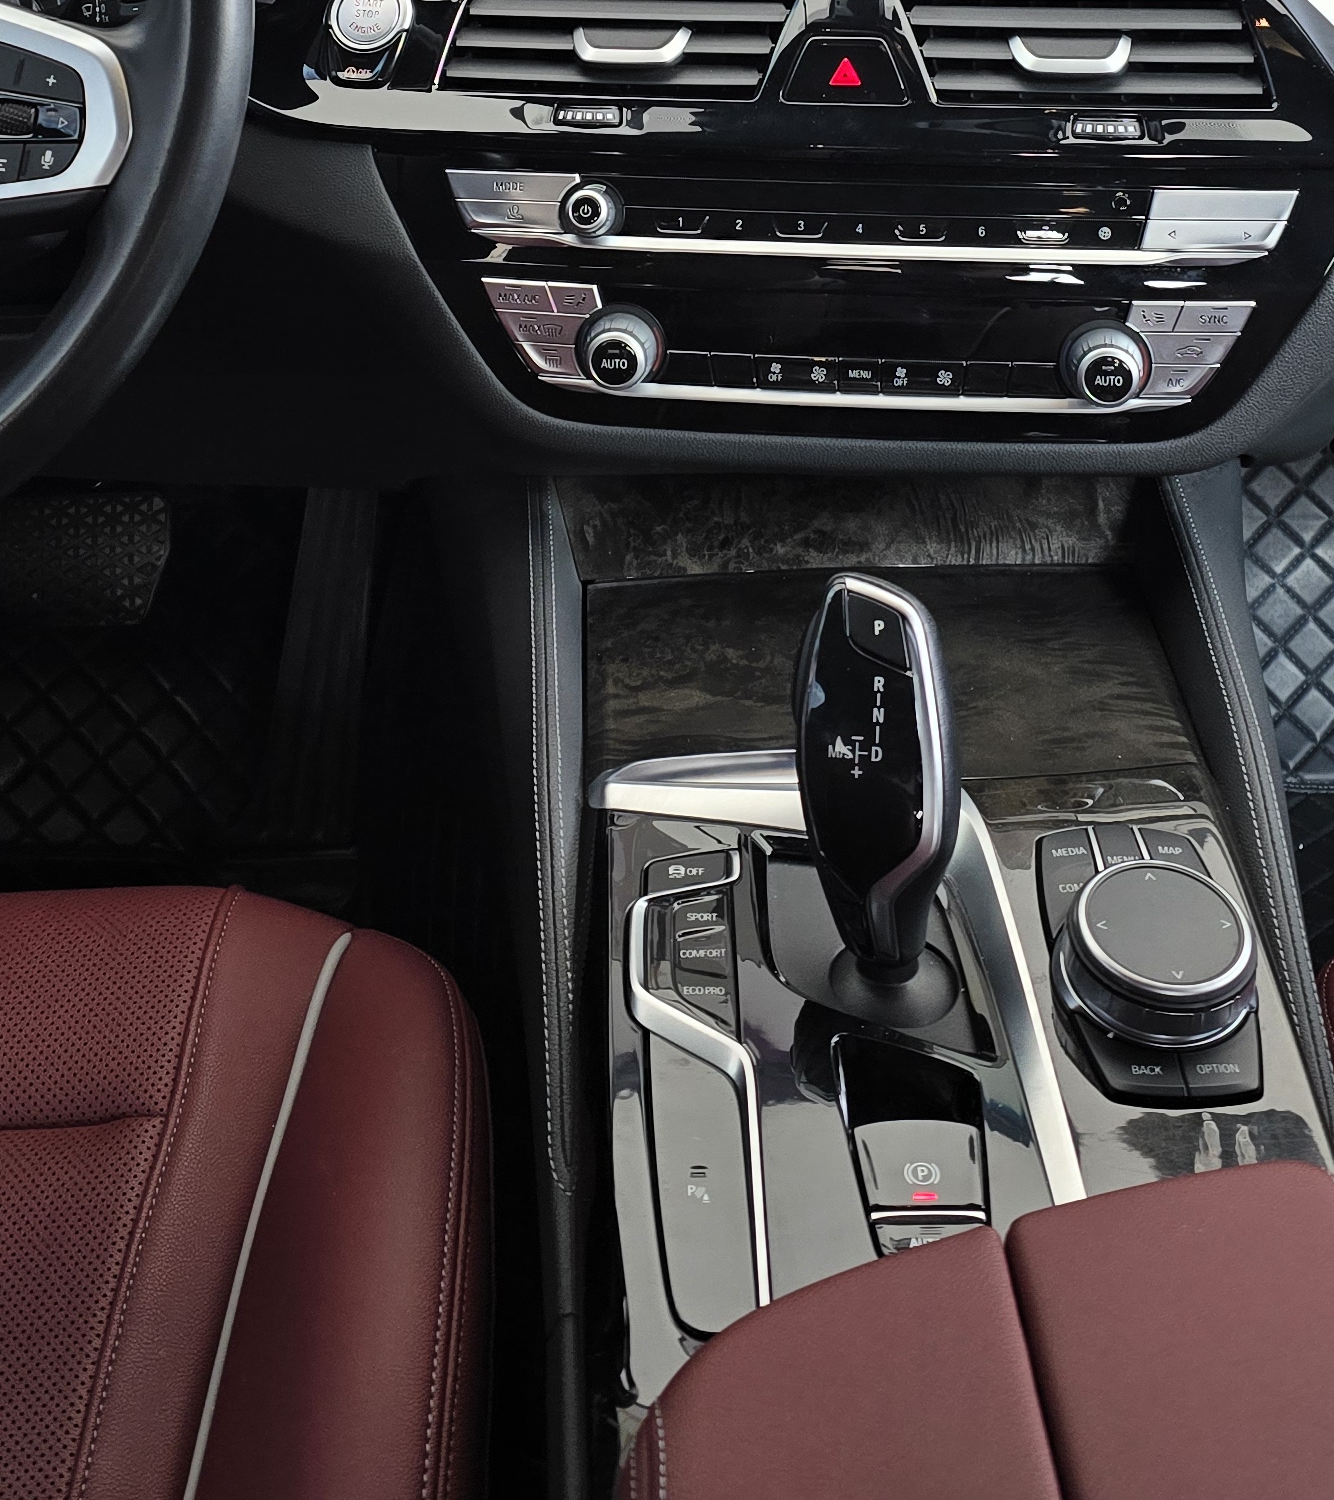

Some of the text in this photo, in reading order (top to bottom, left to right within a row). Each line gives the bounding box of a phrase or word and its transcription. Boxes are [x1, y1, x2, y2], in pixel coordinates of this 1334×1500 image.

[355, 9, 380, 19] STOP
[349, 21, 381, 34] ENGINE
[493, 181, 525, 192] MODE
[677, 217, 684, 229] 1
[735, 219, 743, 231] 2
[797, 220, 805, 232] 3
[856, 223, 864, 234] 4
[919, 224, 926, 236] 5
[978, 226, 985, 238] 6
[1199, 314, 1229, 325] SYNC
[600, 358, 628, 370] AUTO
[768, 373, 783, 382] OFF
[848, 369, 872, 379] MENU
[894, 377, 908, 387] OFF
[1094, 375, 1123, 387] AUTO
[1168, 377, 1185, 389] A/C
[873, 620, 885, 635] P
[873, 676, 885, 692] R
[873, 707, 885, 723] N
[870, 746, 883, 762] D
[1052, 846, 1087, 857] MEDIA
[1157, 846, 1183, 855] MAP
[687, 867, 705, 875] OFF
[687, 913, 717, 921] SPORT
[680, 949, 726, 958] COMFORT
[705, 987, 725, 995] PRO
[1131, 1064, 1163, 1076] BACK
[1196, 1064, 1240, 1074] OPTION
